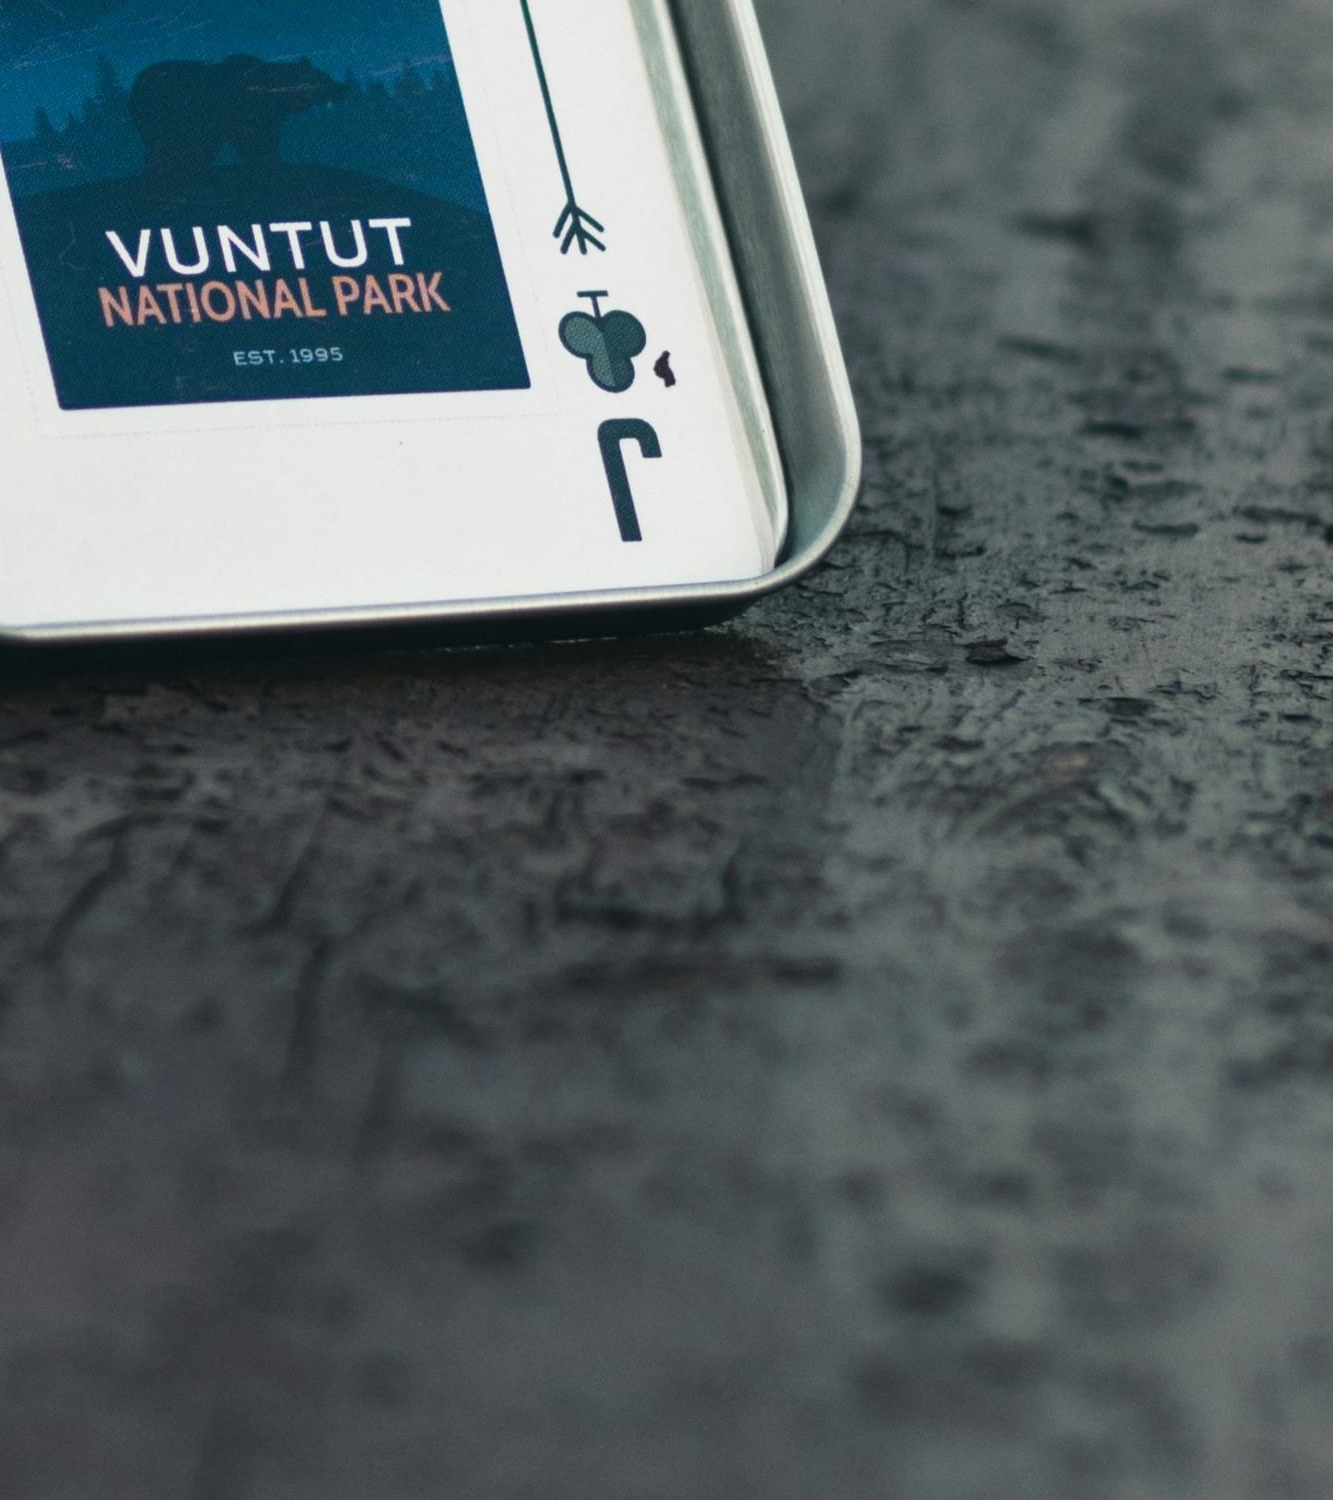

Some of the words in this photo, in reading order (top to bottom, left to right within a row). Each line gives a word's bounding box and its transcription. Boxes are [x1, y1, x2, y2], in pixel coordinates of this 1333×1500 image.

[105, 217, 412, 278] VUNTUT
[98, 277, 328, 327] NATIONAL
[332, 272, 451, 318] PARK
[597, 418, 663, 543] J
